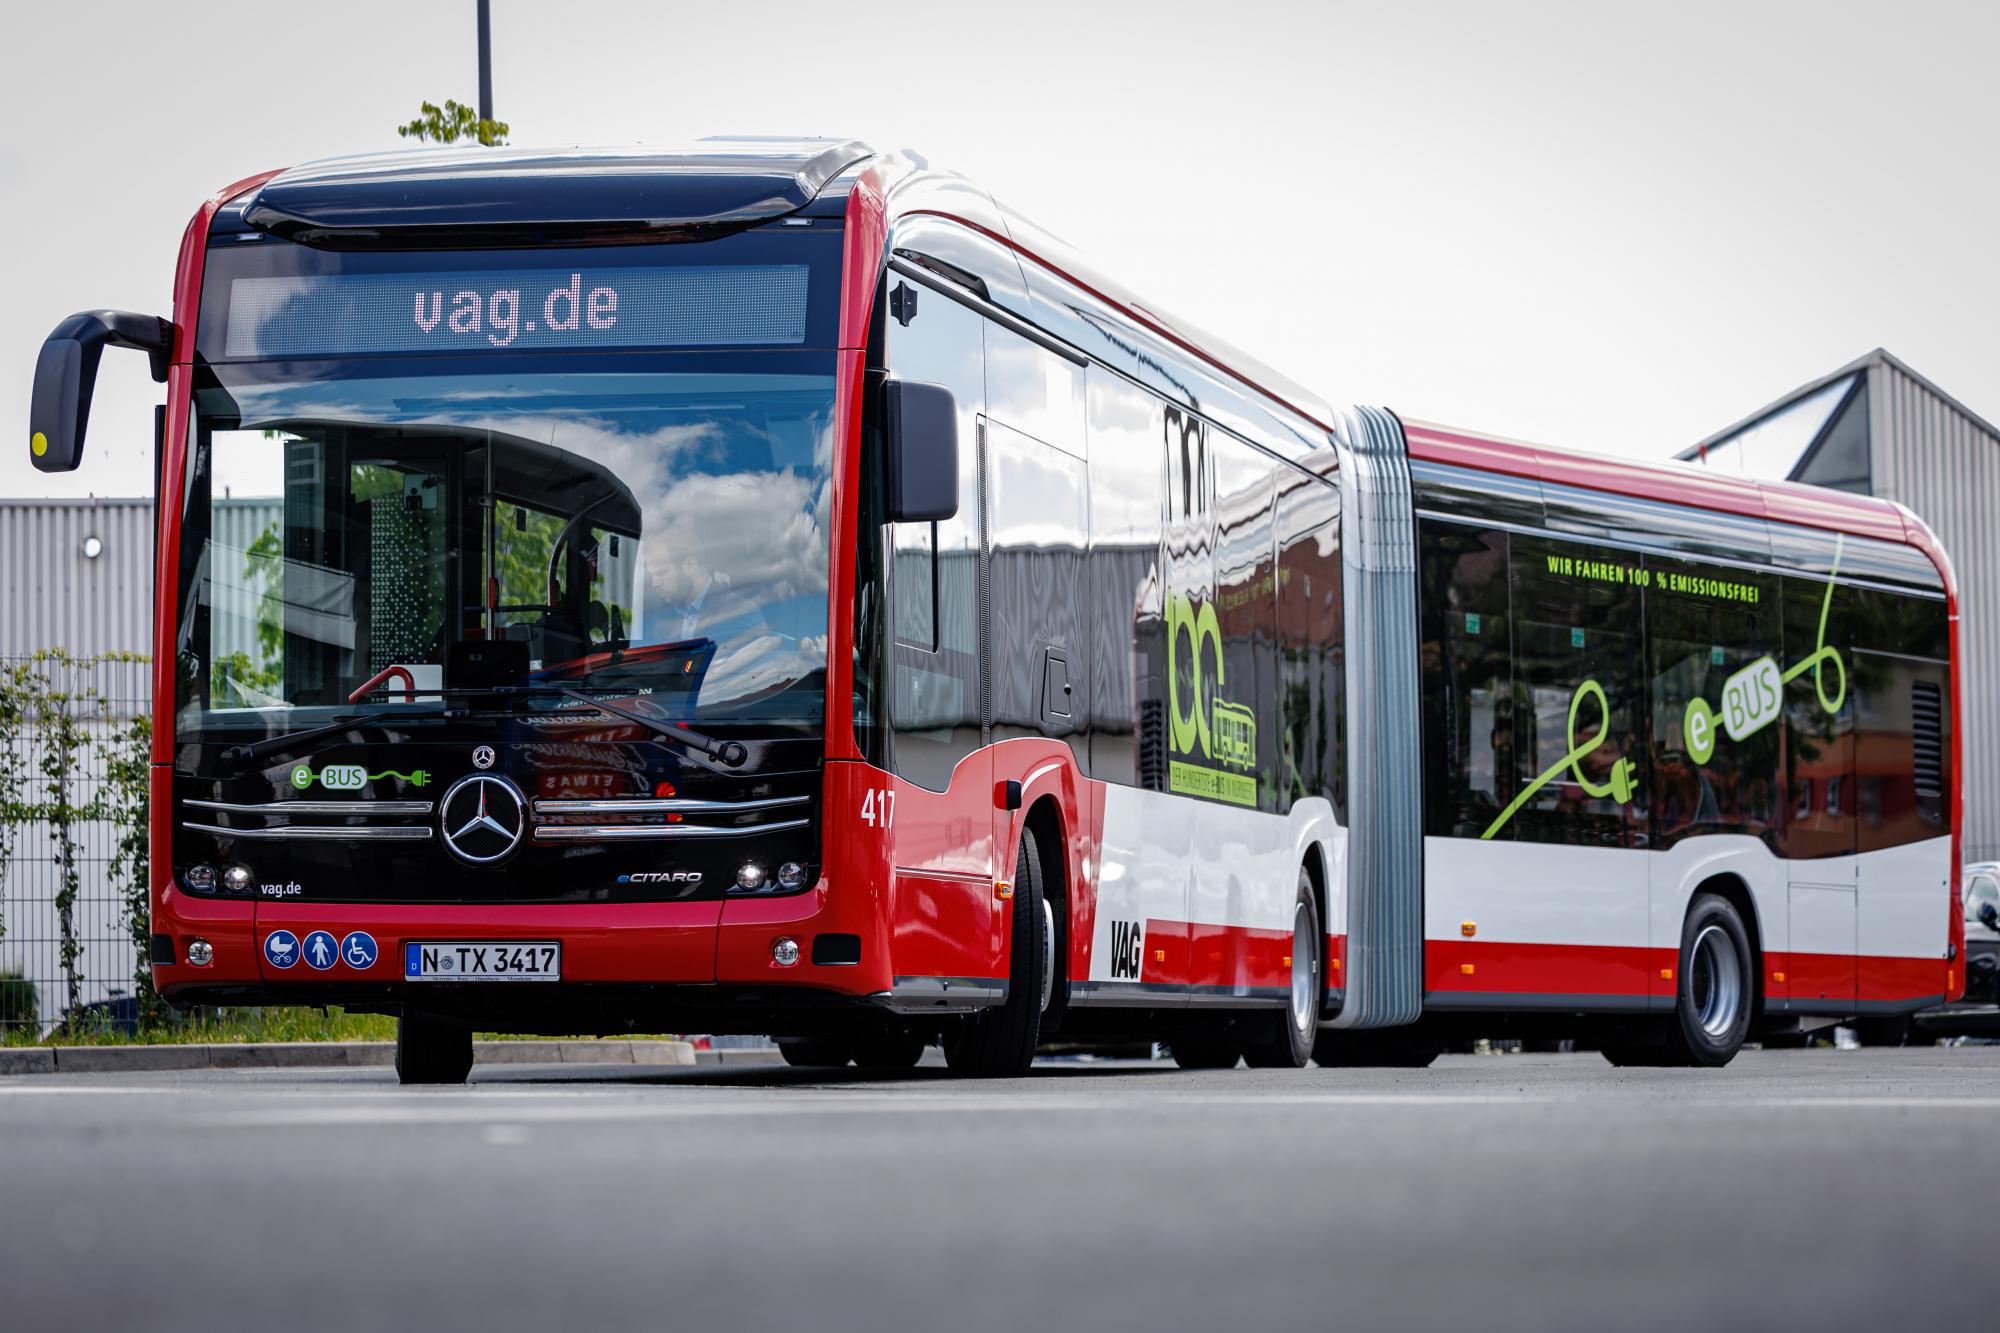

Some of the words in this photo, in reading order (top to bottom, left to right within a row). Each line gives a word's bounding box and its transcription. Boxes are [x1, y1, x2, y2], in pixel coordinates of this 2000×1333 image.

[415, 273, 617, 346] vag.de
[1547, 556, 1572, 576] WIR
[1575, 560, 1624, 583] FAHREN
[1628, 567, 1649, 586] 100
[1656, 571, 1667, 589] %
[1670, 573, 1759, 603] EMISSIONSFREI
[1728, 666, 1776, 732] BUS
[325, 768, 362, 786] BUS
[861, 788, 895, 830] 417
[261, 881, 302, 898] vag.de
[617, 872, 703, 883] eCITARO
[423, 948, 438, 972] N
[456, 948, 487, 972] TX
[494, 948, 556, 973] 3417
[1111, 920, 1141, 980] VAG
